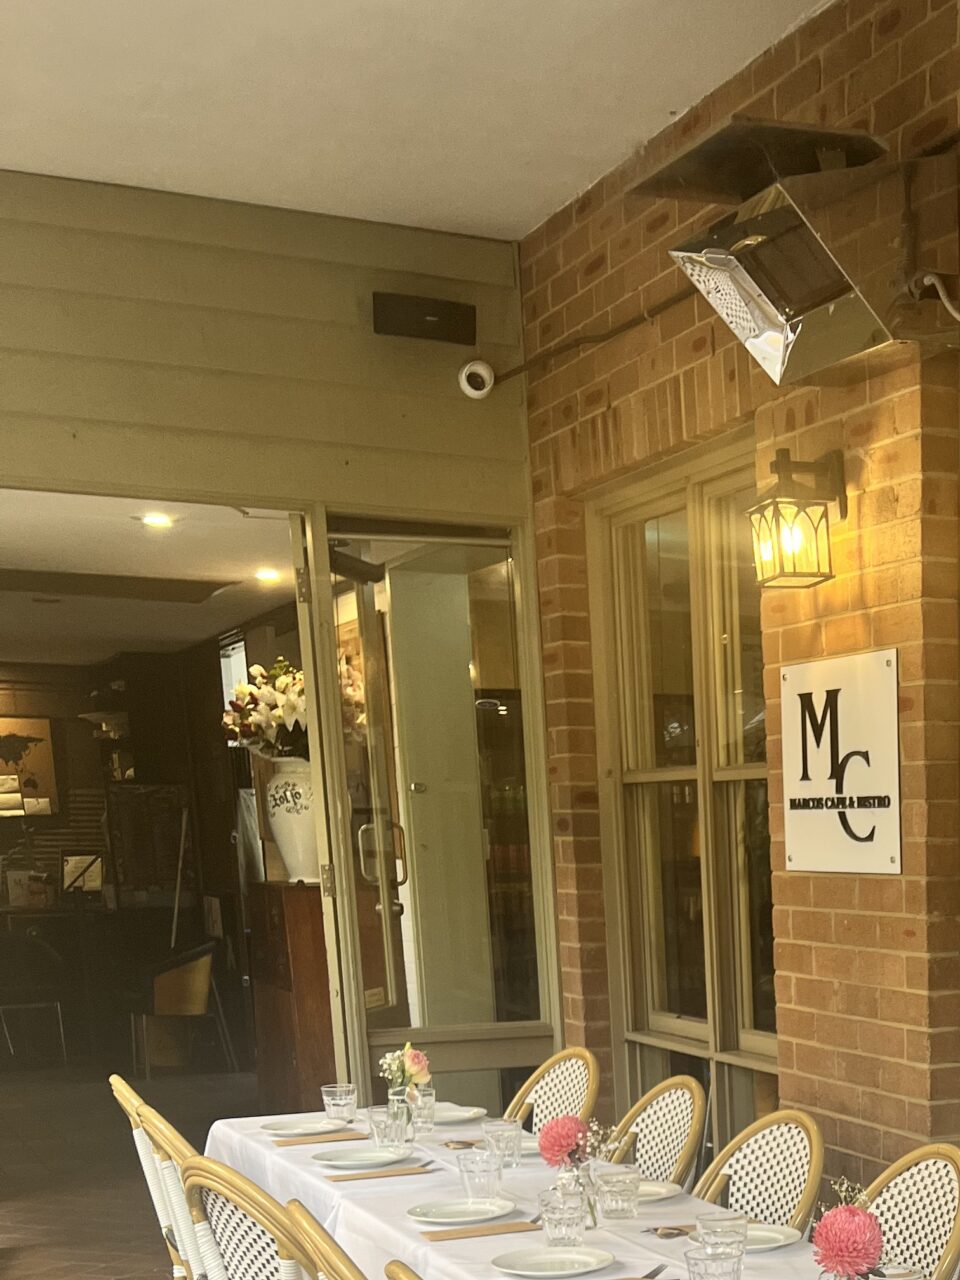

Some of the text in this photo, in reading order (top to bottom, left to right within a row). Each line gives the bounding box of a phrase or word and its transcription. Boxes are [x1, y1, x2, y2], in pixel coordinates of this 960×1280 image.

[789, 797, 824, 810] MARCOS
[848, 796, 856, 809] &
[856, 794, 891, 809] BISTRO
